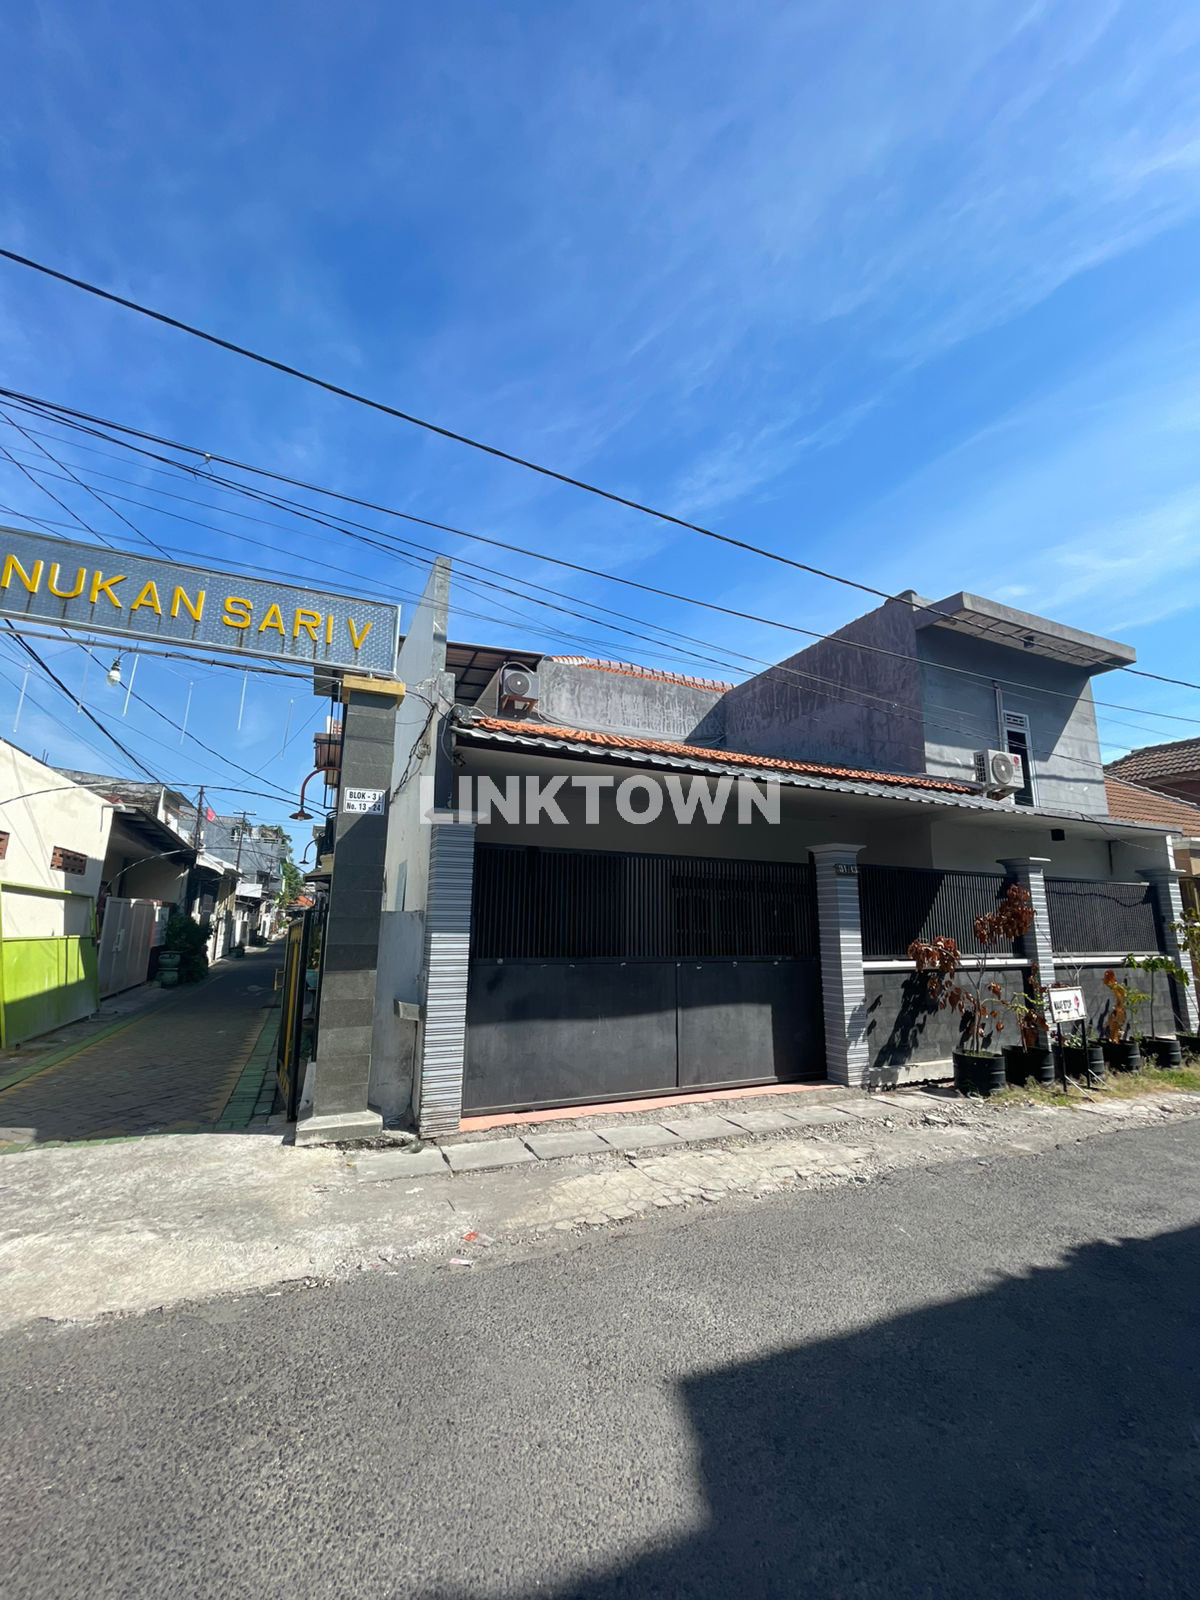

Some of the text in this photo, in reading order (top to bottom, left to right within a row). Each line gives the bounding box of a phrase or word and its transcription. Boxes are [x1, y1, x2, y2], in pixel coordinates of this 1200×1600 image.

[1, 554, 373, 650] NUKAN SARI V
[349, 791, 366, 799] BLOK
[346, 802, 356, 810] No.
[359, 803, 367, 811] 13
[372, 803, 381, 811] 24
